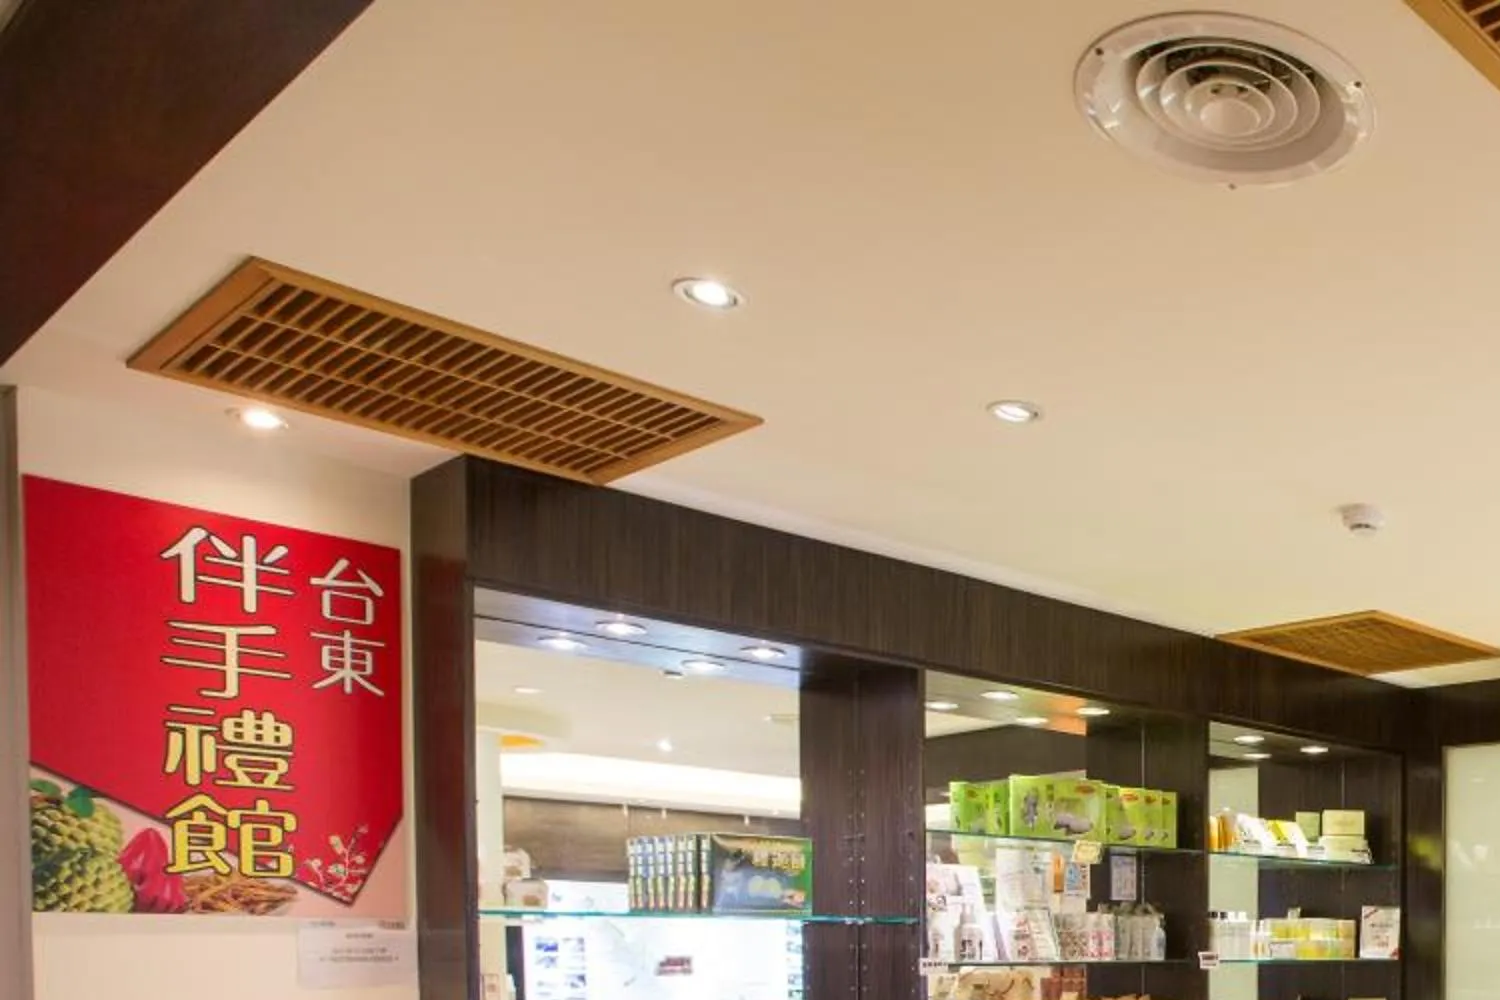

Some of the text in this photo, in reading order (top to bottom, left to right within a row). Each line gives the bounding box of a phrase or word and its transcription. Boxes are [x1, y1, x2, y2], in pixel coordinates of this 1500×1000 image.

[161, 526, 297, 878] 伴手禮館
[310, 558, 385, 697] 台東
